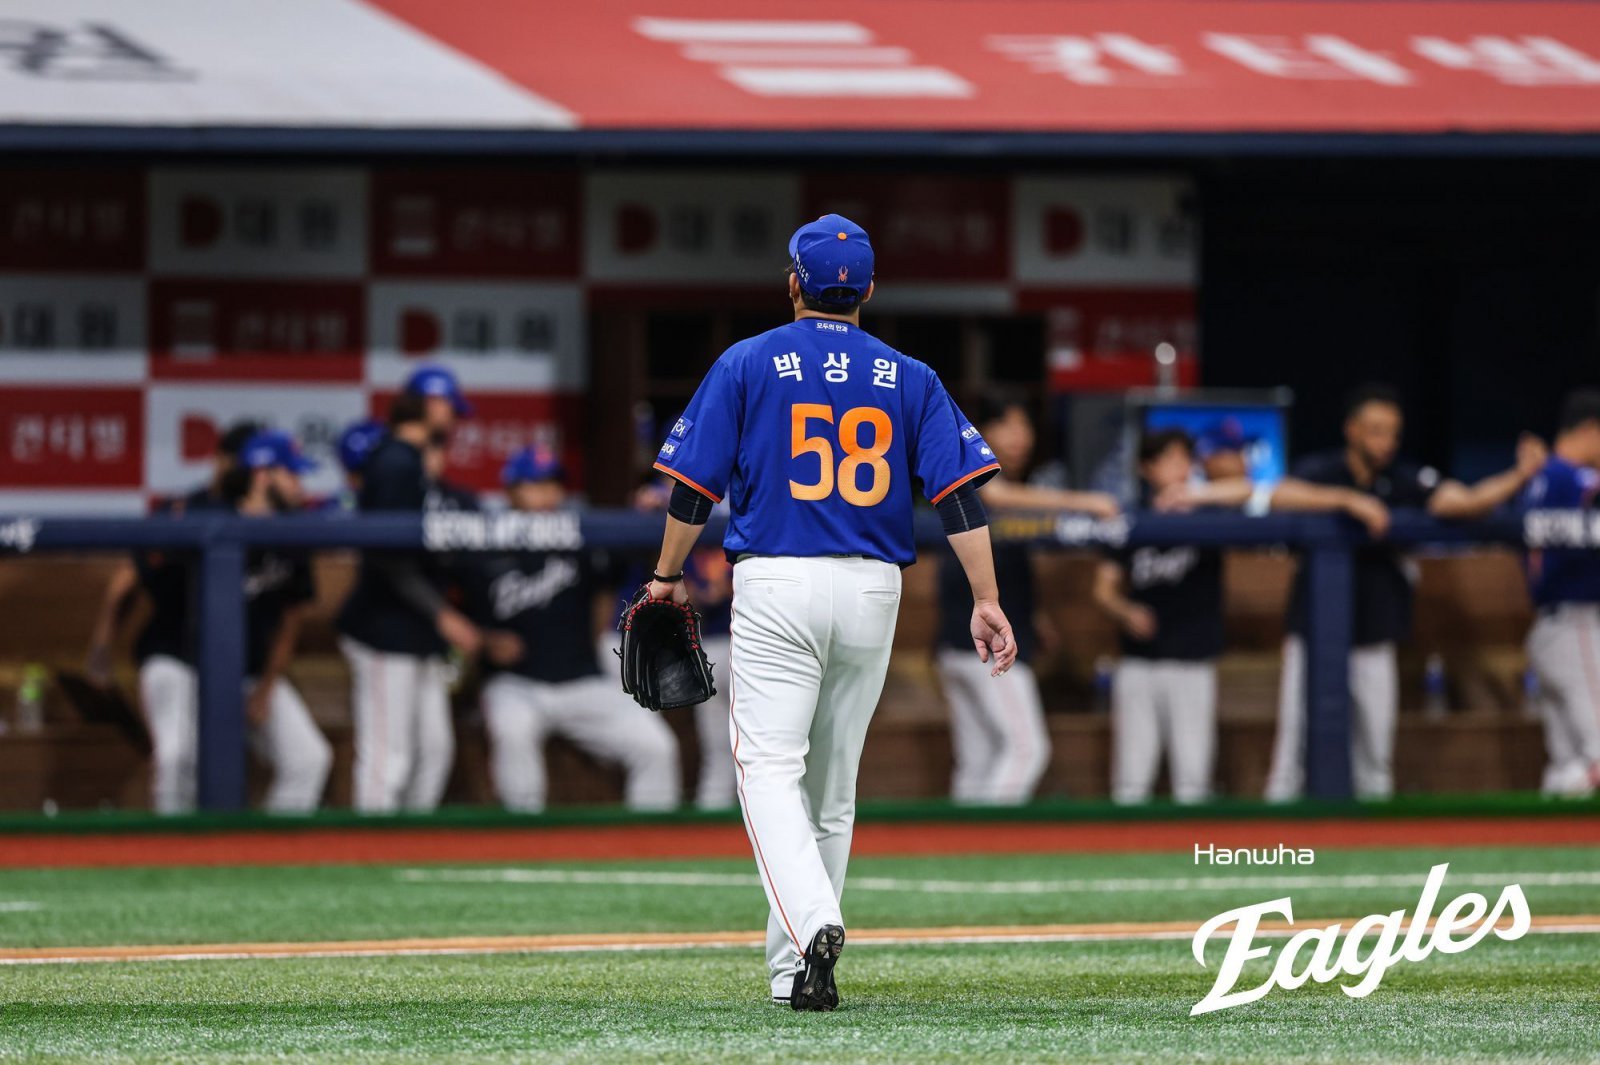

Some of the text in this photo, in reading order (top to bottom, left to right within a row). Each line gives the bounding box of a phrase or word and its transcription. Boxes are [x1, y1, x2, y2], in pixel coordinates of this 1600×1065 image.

[816, 322, 835, 331] 모두의
[772, 351, 898, 389] 박상원
[788, 403, 893, 507] 58
